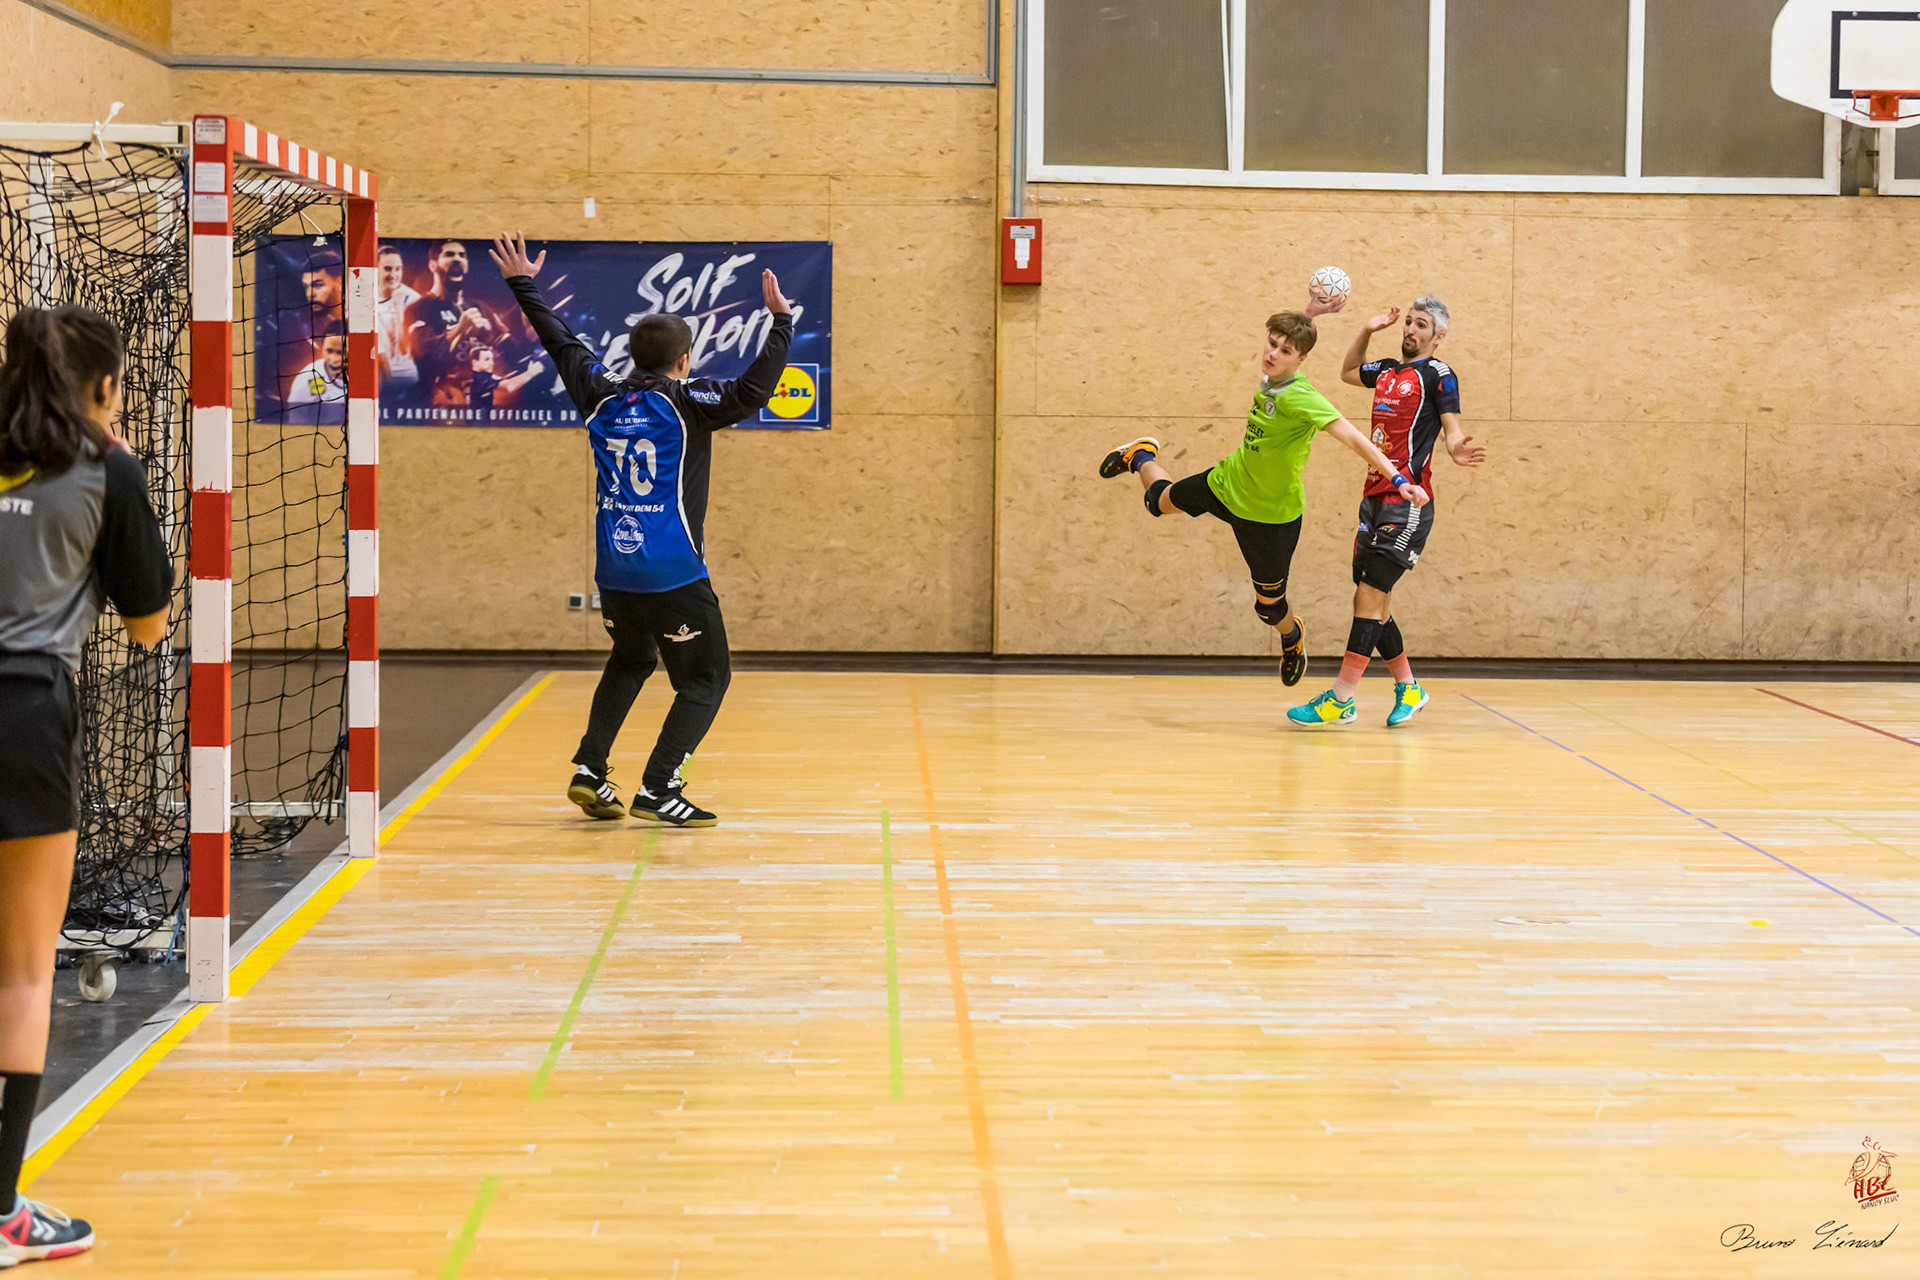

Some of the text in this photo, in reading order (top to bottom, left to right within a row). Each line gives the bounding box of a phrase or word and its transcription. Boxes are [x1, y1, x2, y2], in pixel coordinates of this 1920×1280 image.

[397, 408, 482, 421] PARTENAIRE
[489, 409, 553, 422] OFFICIEL
[560, 409, 577, 422] DU
[605, 438, 657, 497] 70
[652, 503, 665, 513] 54
